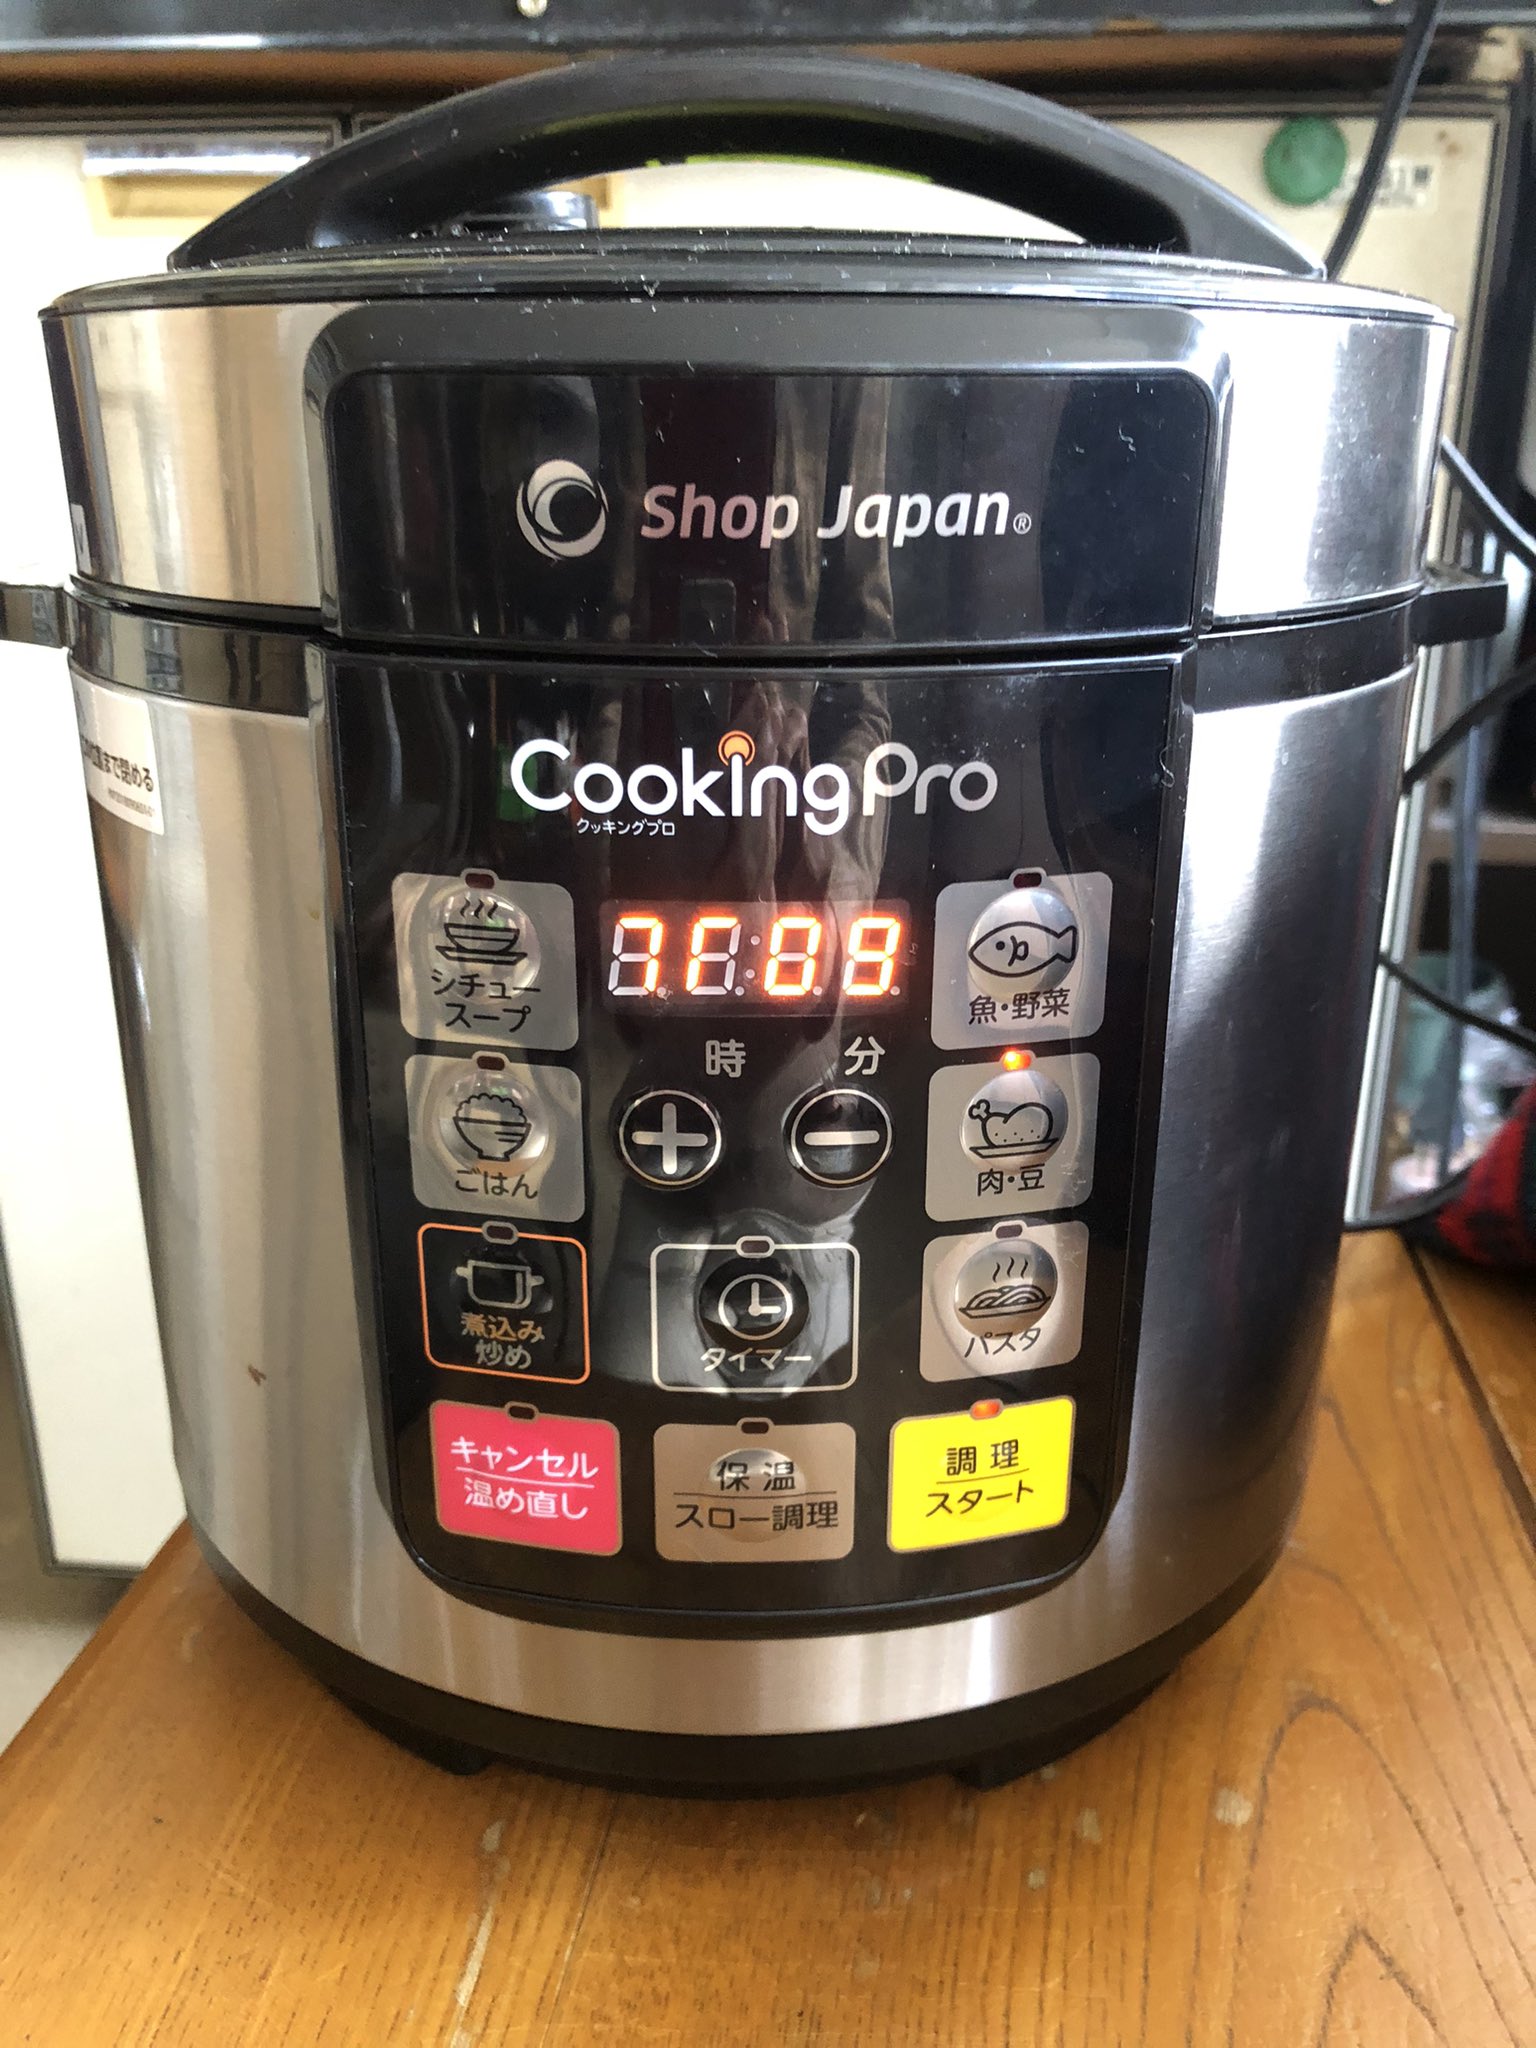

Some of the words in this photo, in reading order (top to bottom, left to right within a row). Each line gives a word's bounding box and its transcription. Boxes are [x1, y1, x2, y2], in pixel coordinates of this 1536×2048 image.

[641, 482, 800, 548] Shop
[576, 817, 676, 837] クッキングプロ
[431, 968, 541, 999] シチュー
[445, 1002, 532, 1033] スープ
[968, 988, 1071, 1026] 魚・野菜
[705, 1038, 747, 1078] 時
[844, 1035, 886, 1076] 分
[455, 1168, 538, 1200] ごはん
[977, 1163, 1046, 1197] 肉・豆
[460, 1312, 546, 1344] 煮込み
[964, 1326, 1042, 1359] パスタ
[475, 1340, 532, 1370] 炒め
[700, 1347, 812, 1373] タイマー
[450, 1435, 600, 1479] キャンセル
[463, 1476, 589, 1521] 温め直し
[925, 1479, 1035, 1518] スタート
[675, 1500, 839, 1532] スロー調理
